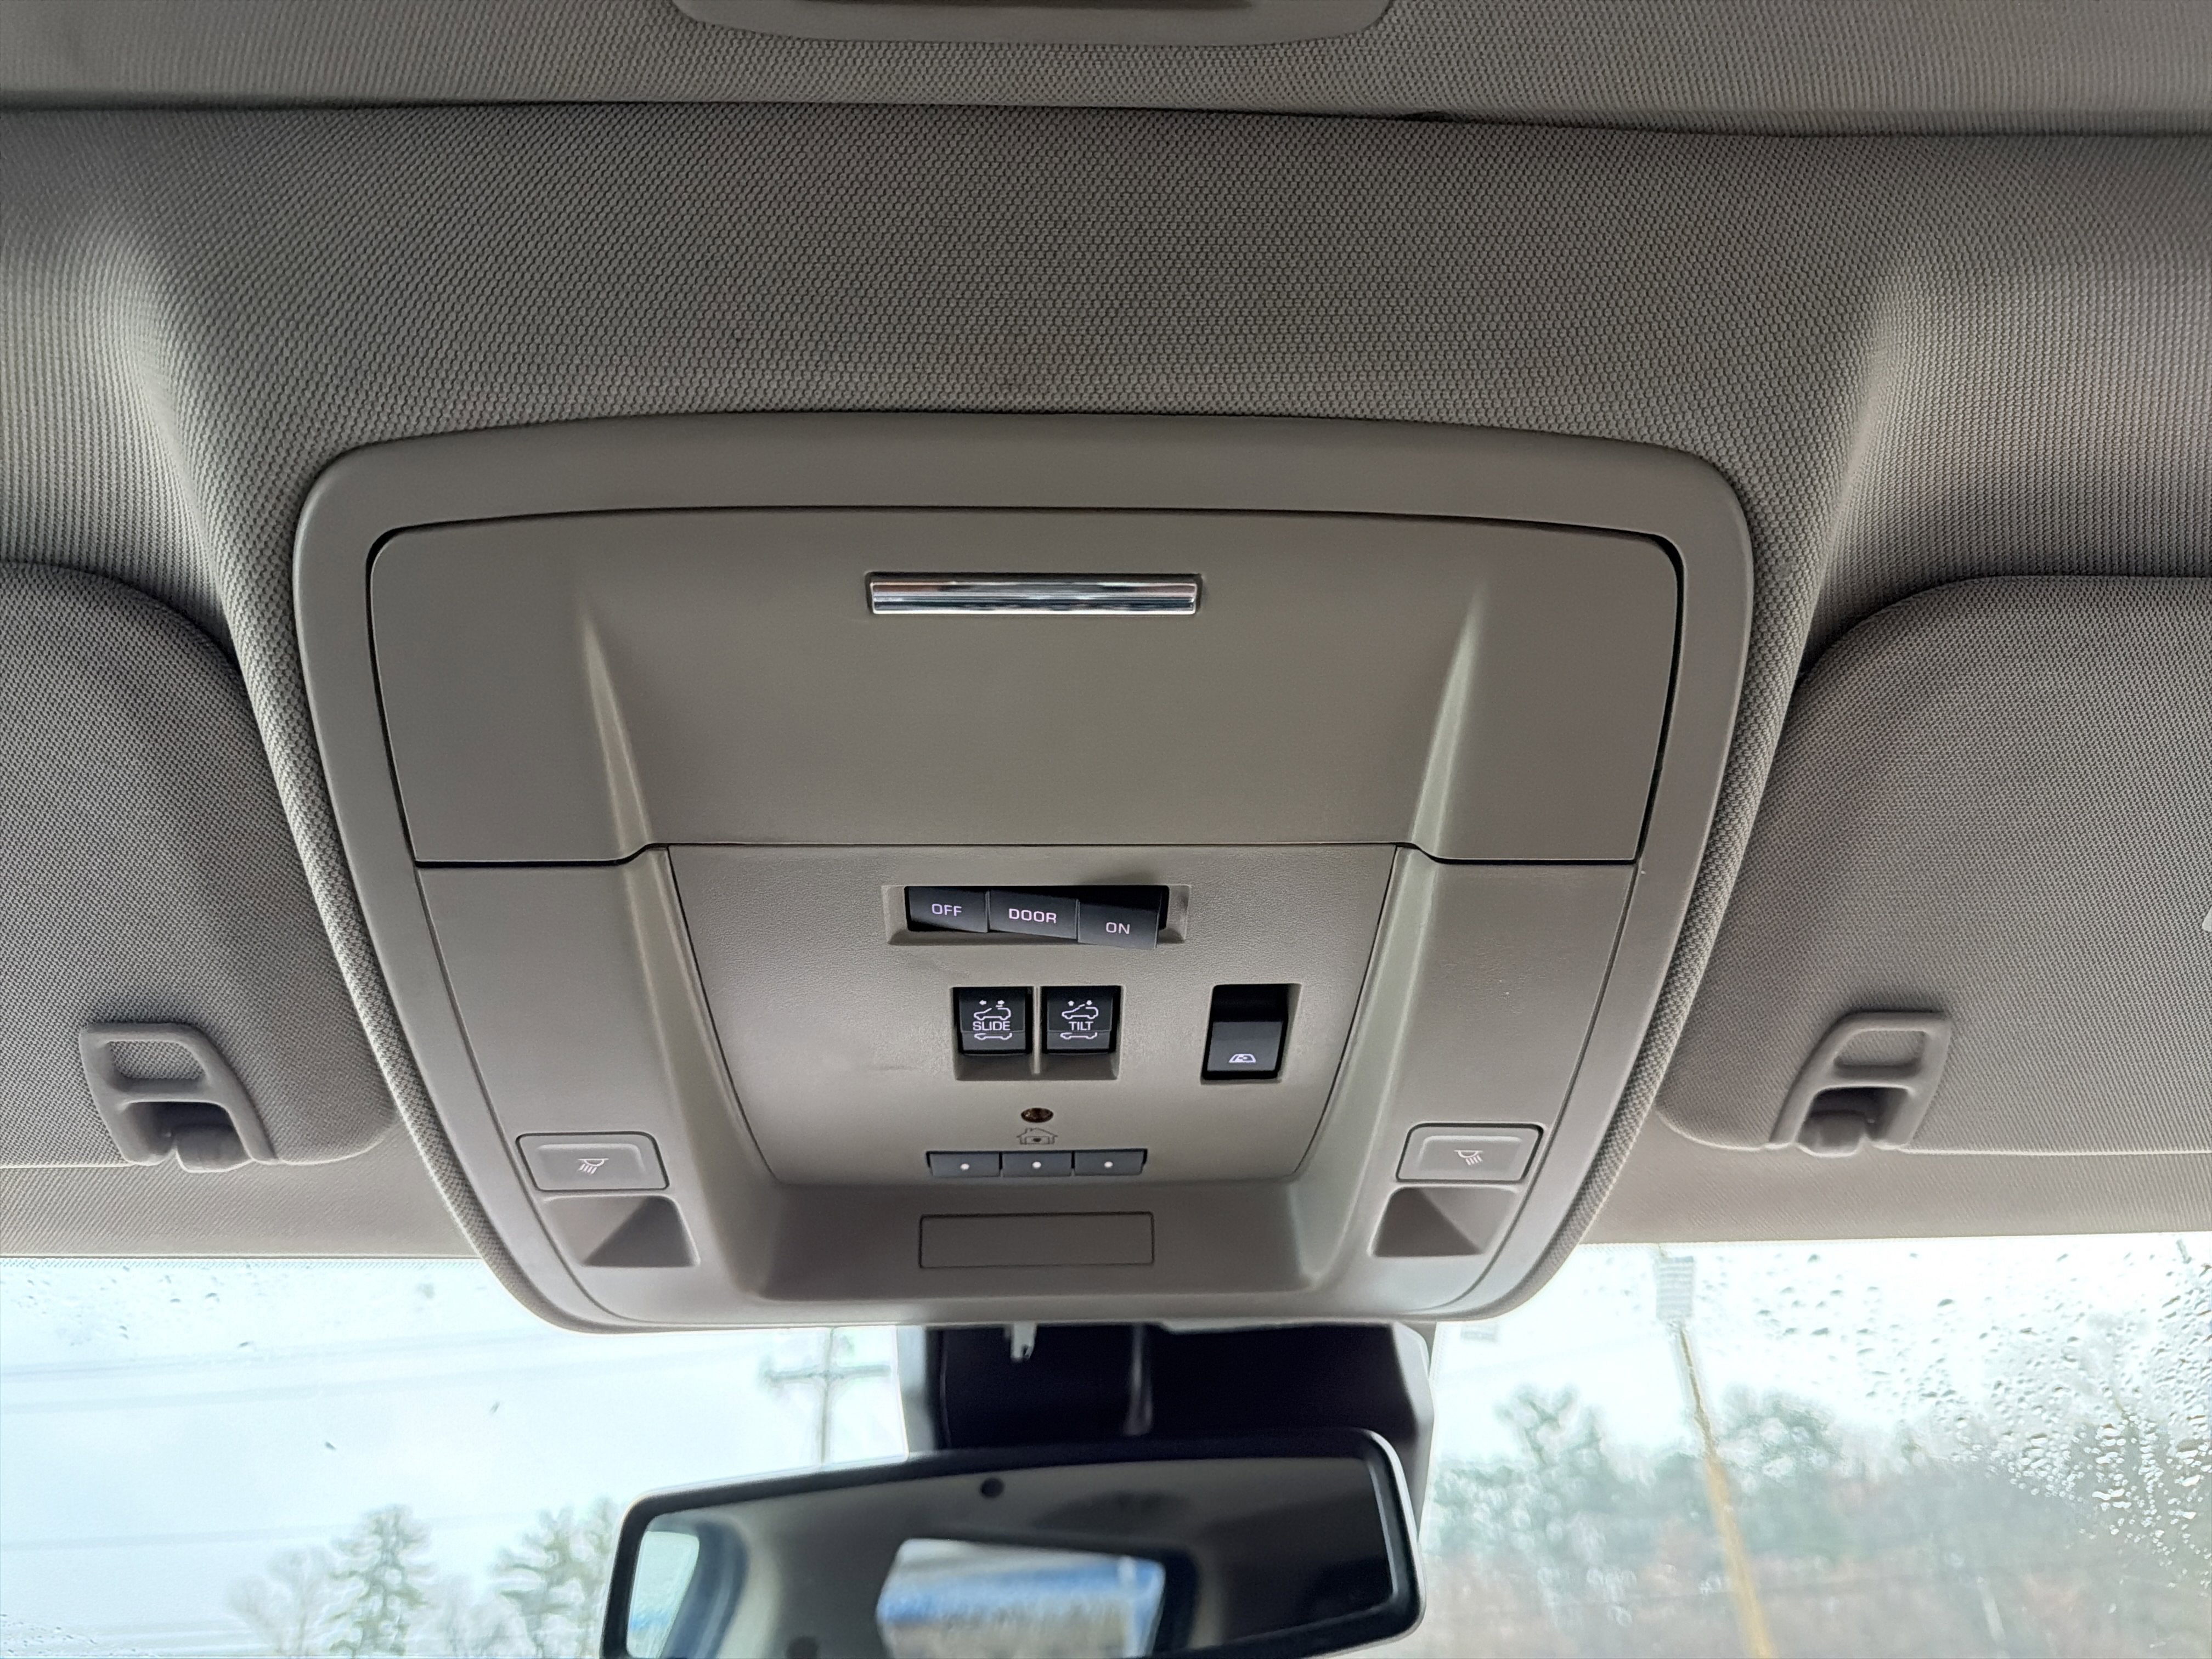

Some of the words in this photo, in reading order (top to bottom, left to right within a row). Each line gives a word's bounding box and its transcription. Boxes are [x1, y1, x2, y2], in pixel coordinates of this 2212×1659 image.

[932, 904, 962, 917] OFF
[1008, 909, 1057, 924] DOOR
[1105, 922, 1130, 934] ON
[973, 1021, 1011, 1031] SLIDE
[1068, 1021, 1094, 1031] TILT
